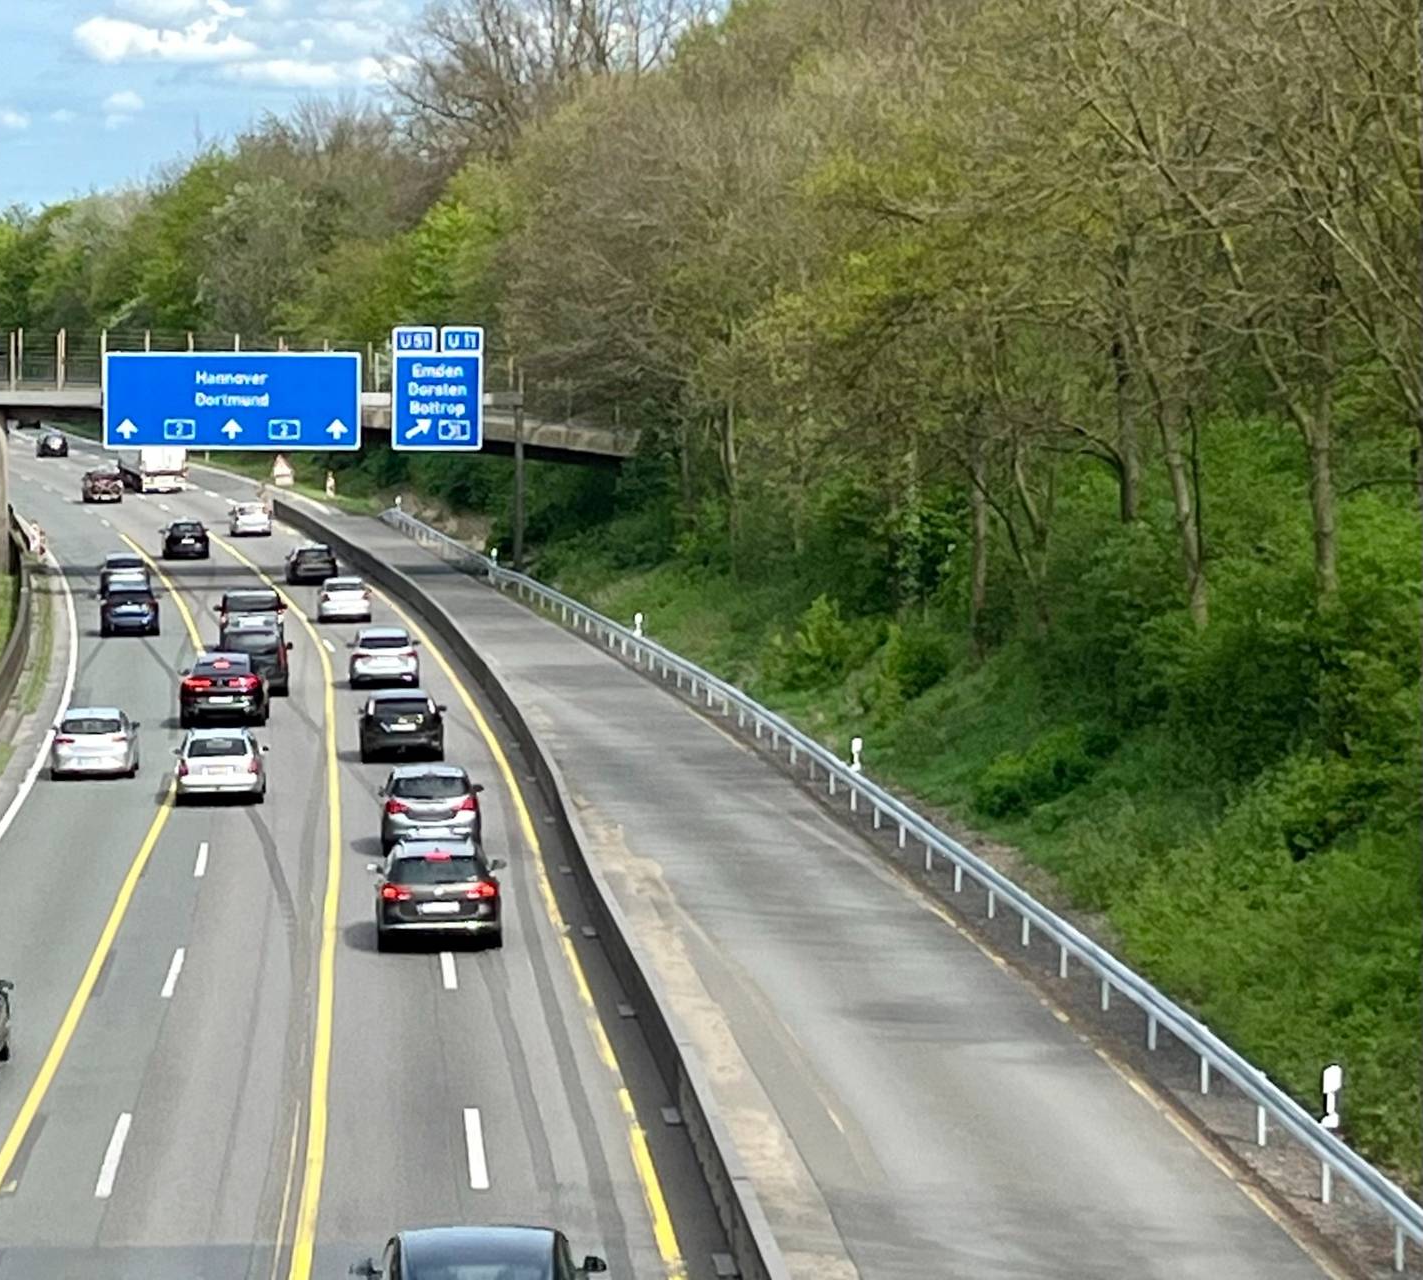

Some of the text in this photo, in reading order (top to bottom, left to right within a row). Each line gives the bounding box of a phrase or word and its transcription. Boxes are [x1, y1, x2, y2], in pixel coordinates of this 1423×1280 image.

[195, 370, 269, 385] Hannover
[412, 362, 464, 378] Emden
[408, 381, 467, 397] Dorsten
[195, 392, 269, 407] Dortmund
[409, 400, 466, 418] Bottrop
